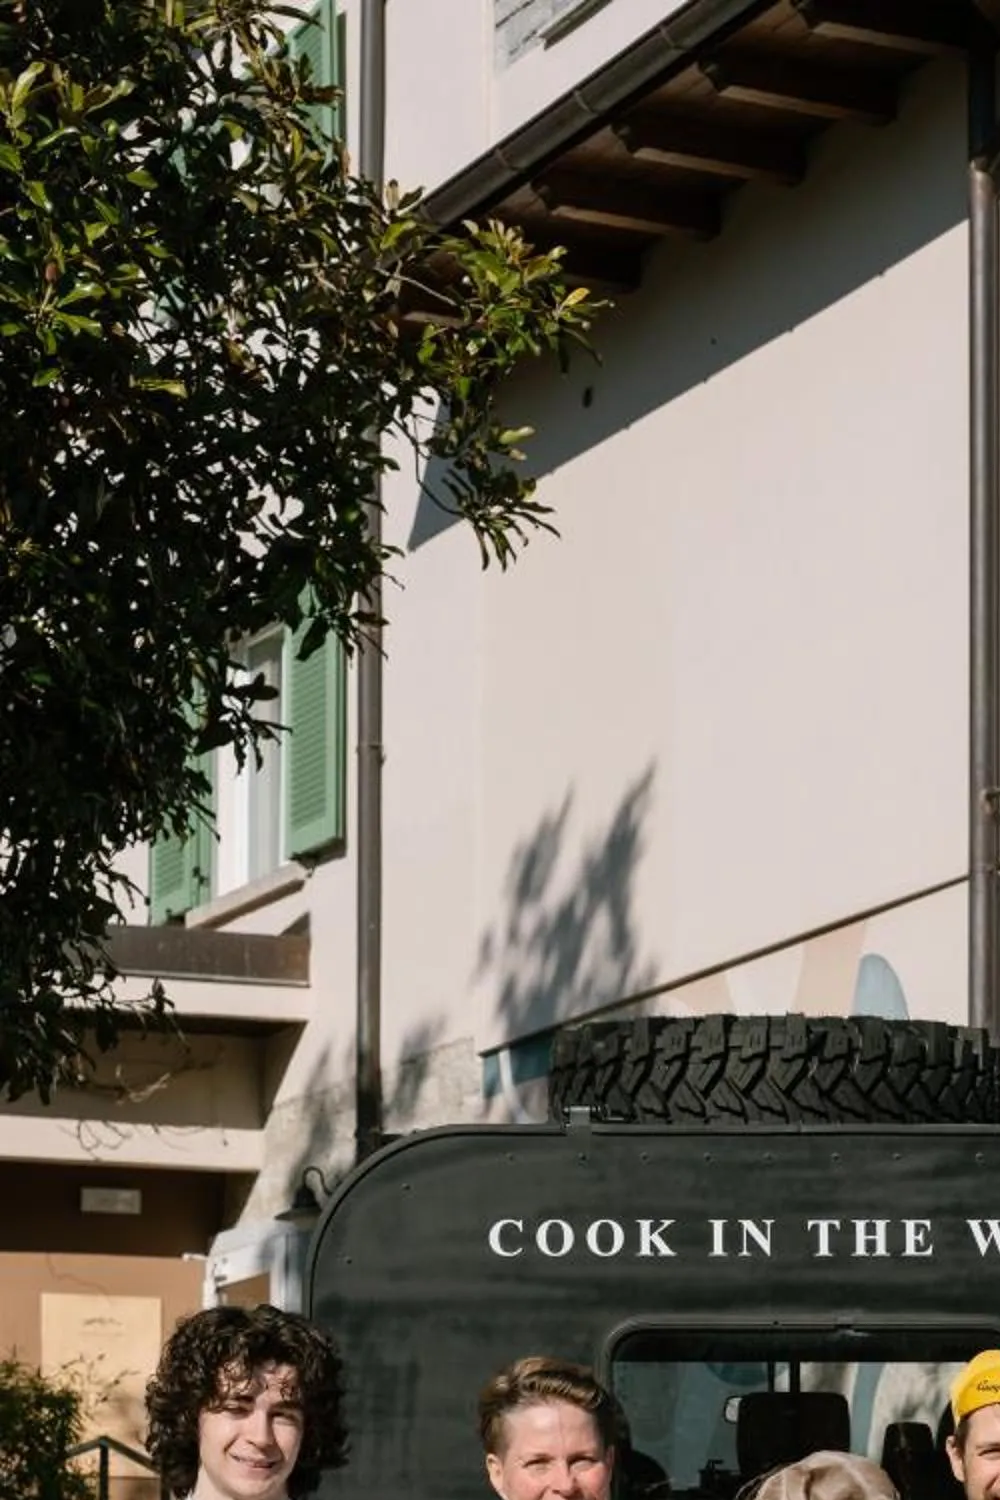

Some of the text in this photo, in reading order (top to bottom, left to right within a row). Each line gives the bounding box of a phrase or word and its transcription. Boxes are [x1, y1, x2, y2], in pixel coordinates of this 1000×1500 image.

[487, 1218, 677, 1257] COOK
[707, 1218, 775, 1257] IN
[806, 1218, 934, 1257] THE
